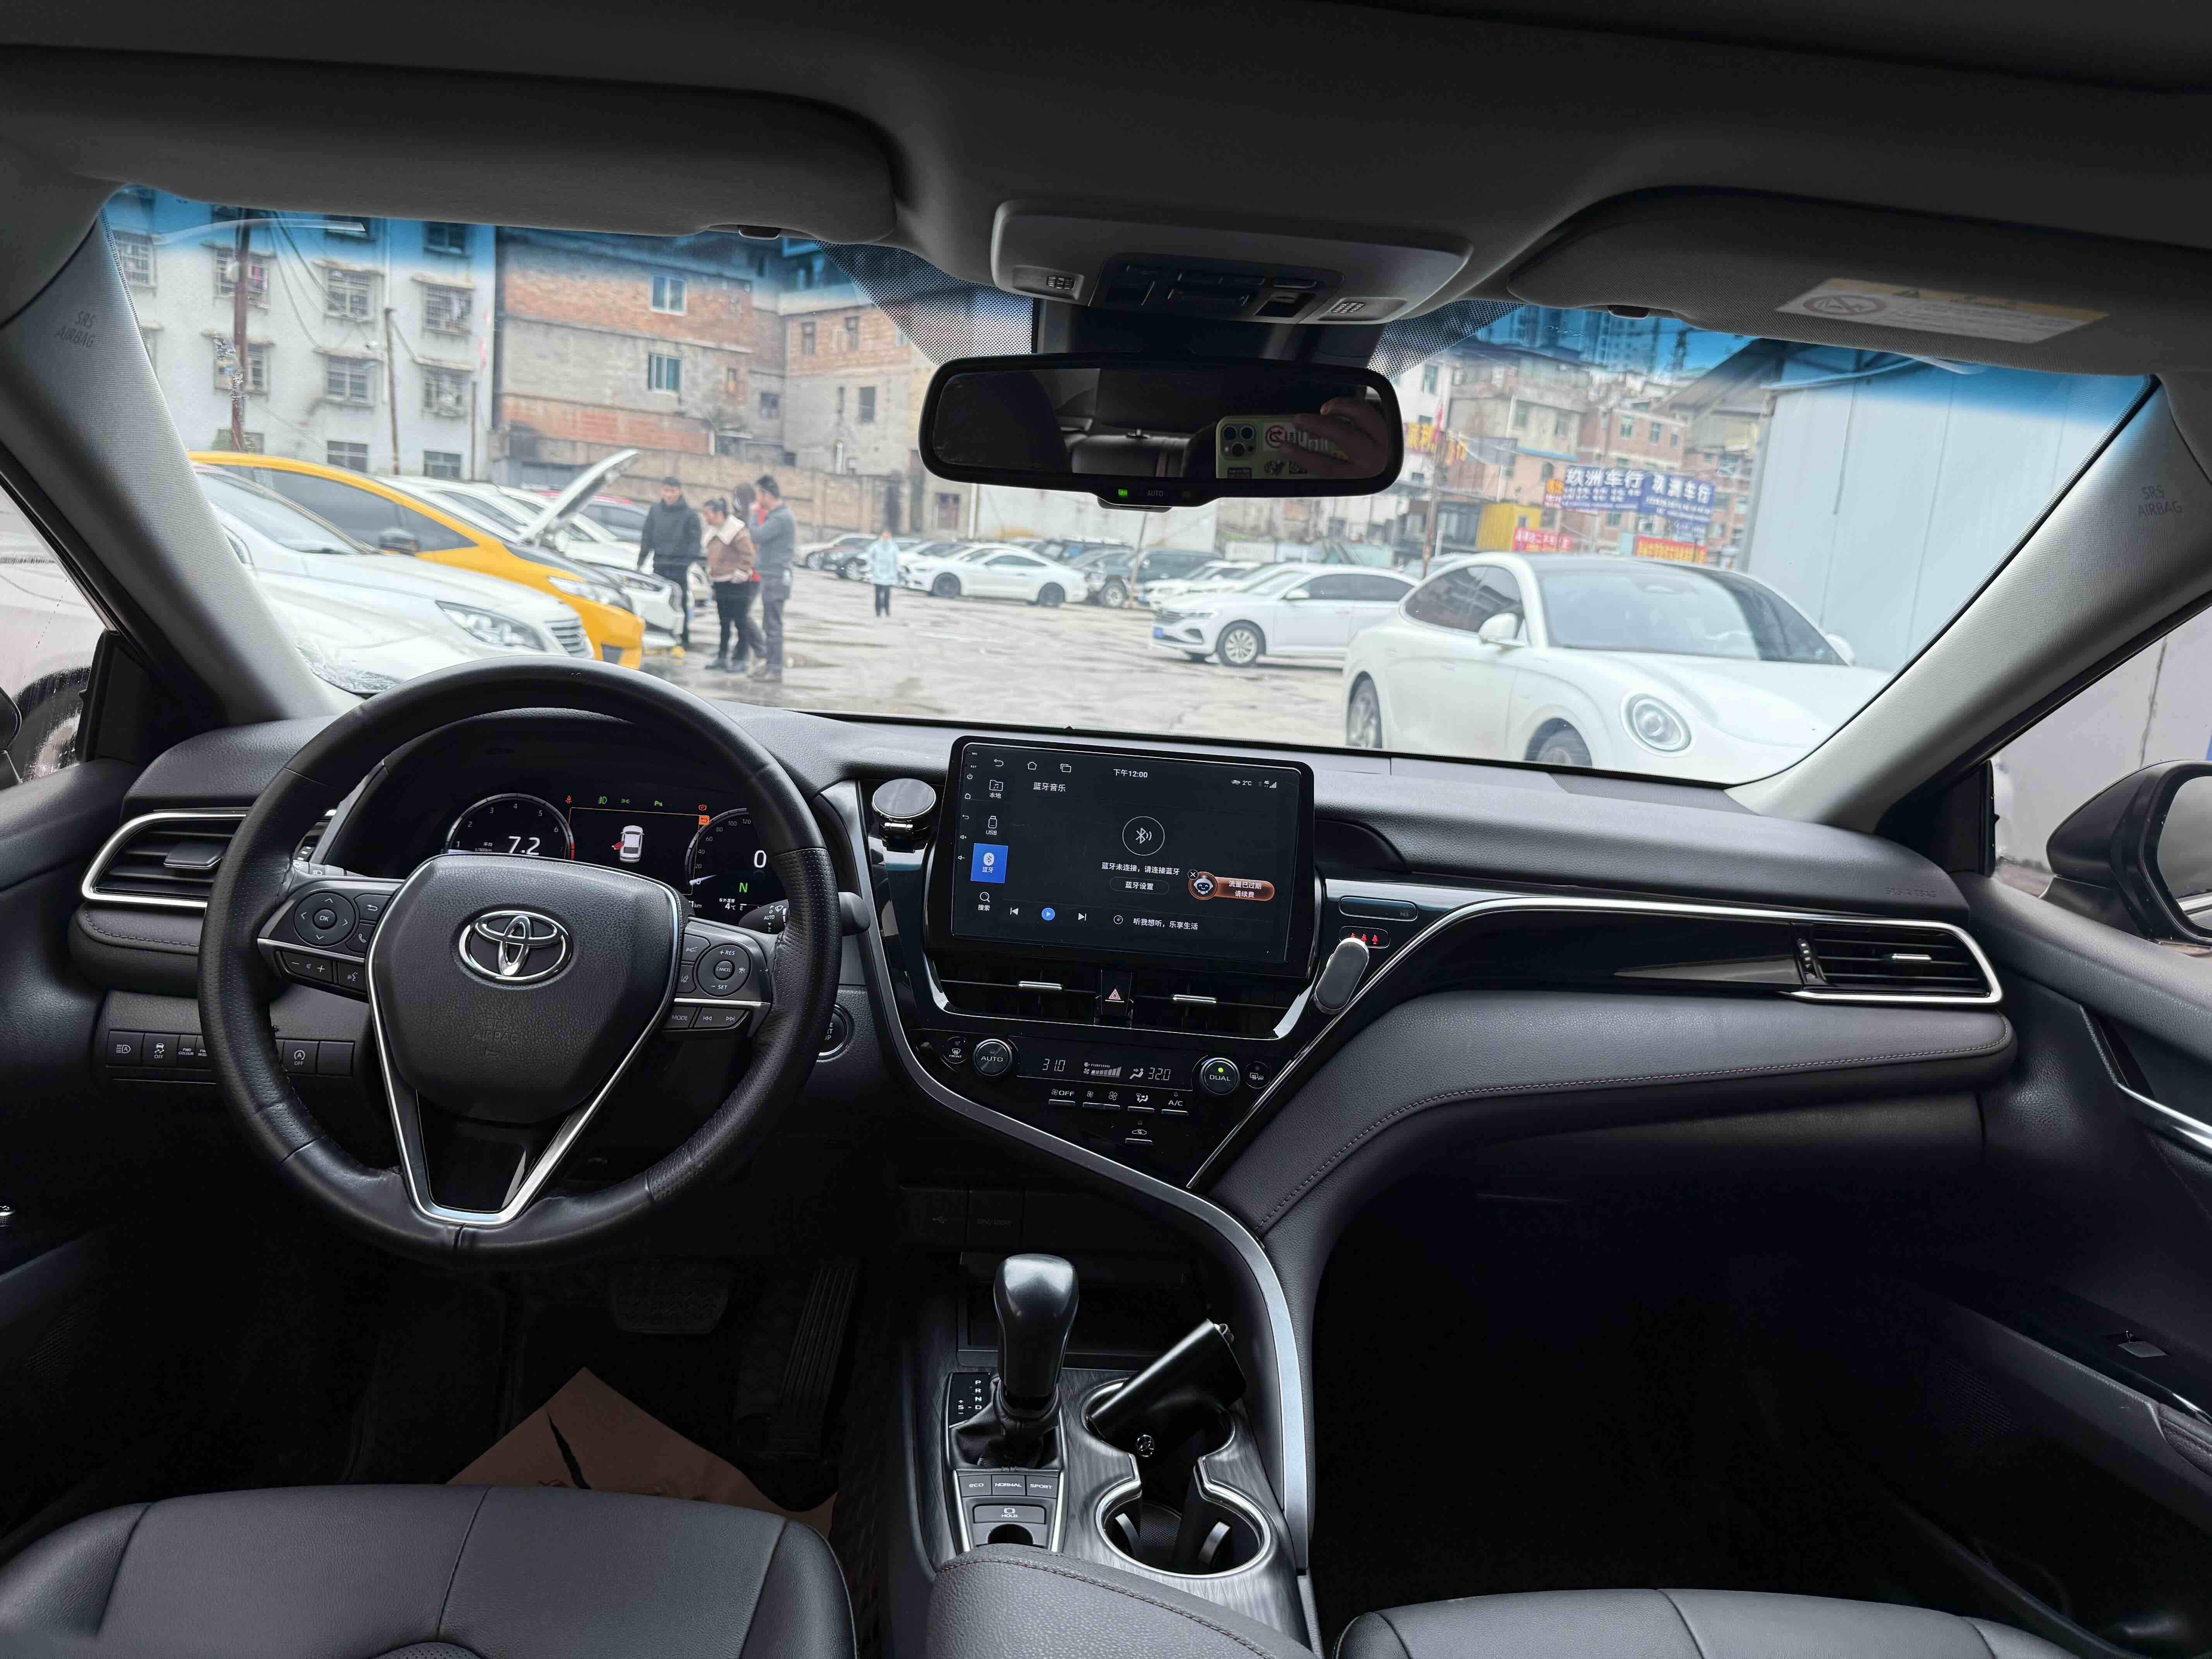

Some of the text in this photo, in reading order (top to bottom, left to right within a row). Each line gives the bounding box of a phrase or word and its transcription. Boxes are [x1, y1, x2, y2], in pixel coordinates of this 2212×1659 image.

[2142, 485, 2165, 500] SRS
[2138, 501, 2183, 517] AIRBAG
[1113, 769, 1148, 778] 下午12:00
[1033, 782, 1066, 792] 蓝牙音乐
[508, 836, 540, 855] 7.2
[754, 850, 767, 868] 0
[1101, 862, 1180, 876] 蓝牙未连接，请连接蓝牙
[739, 882, 748, 893] N
[1125, 881, 1154, 890] 蓝牙设置
[1228, 880, 1262, 890] 流量已过期
[1235, 890, 1254, 898] 请续费
[1133, 918, 1199, 930] 听我想听，乐享生活
[486, 1017, 508, 1029] SRS
[472, 1030, 519, 1045] AIRBAG
[1042, 1058, 1066, 1072] 31.0
[1148, 1067, 1171, 1081] 32.0
